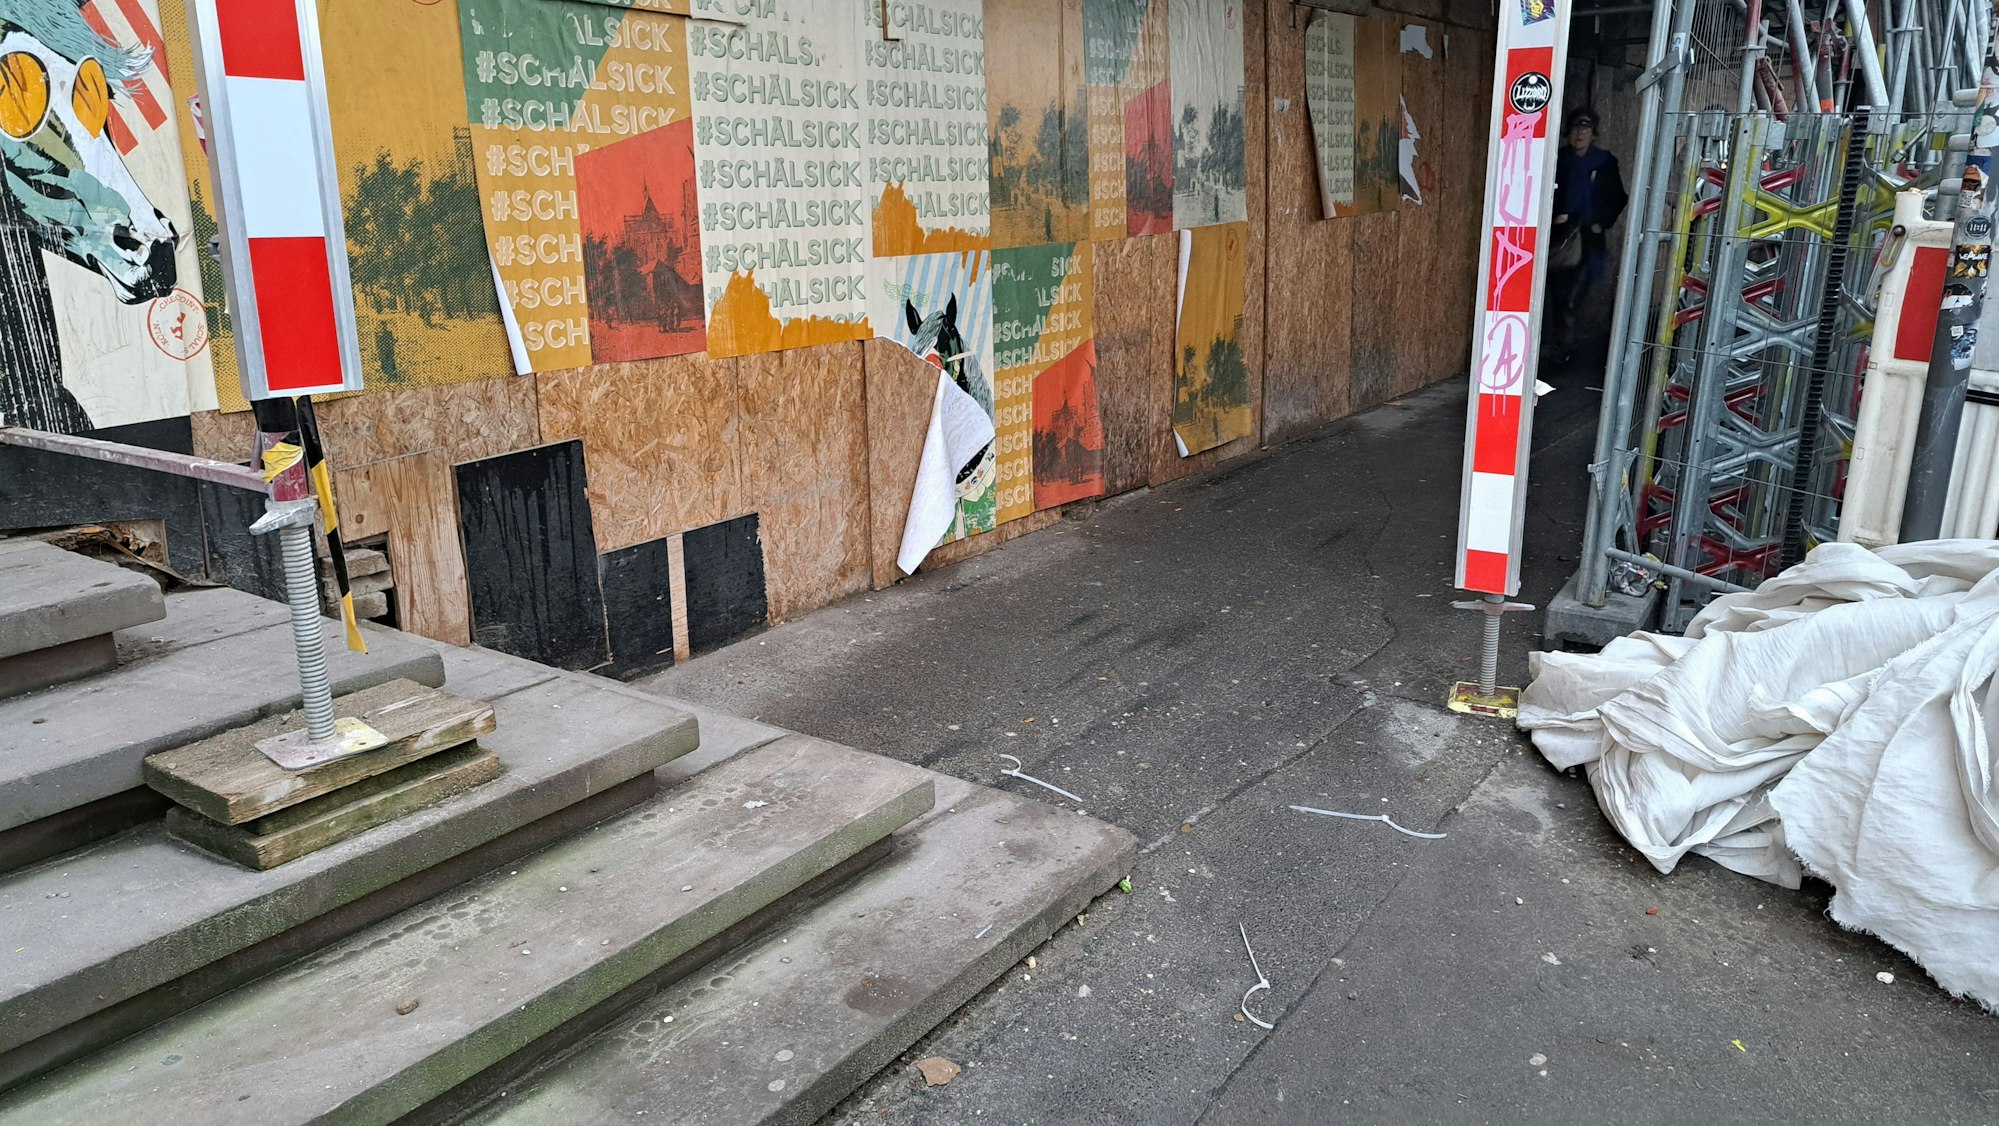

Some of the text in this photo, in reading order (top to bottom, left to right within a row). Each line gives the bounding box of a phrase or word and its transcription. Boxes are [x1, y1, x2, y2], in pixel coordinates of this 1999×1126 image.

[476, 50, 676, 95] #SCHÄLSICK
[865, 39, 986, 76] #SCHÄLSICK
[694, 71, 860, 110] #SCHÄLSICK
[866, 79, 987, 112] #SCHÄLSICK
[697, 115, 862, 149] #SCHÄLSICK
[868, 116, 988, 147] #SCHÄLSICK
[699, 157, 863, 189] #SCHÄLSICK
[869, 154, 990, 183] #SCHÄLSICK
[702, 197, 864, 232] #SCHÄLSICK
[705, 237, 865, 274] #SCHÄLSICK
